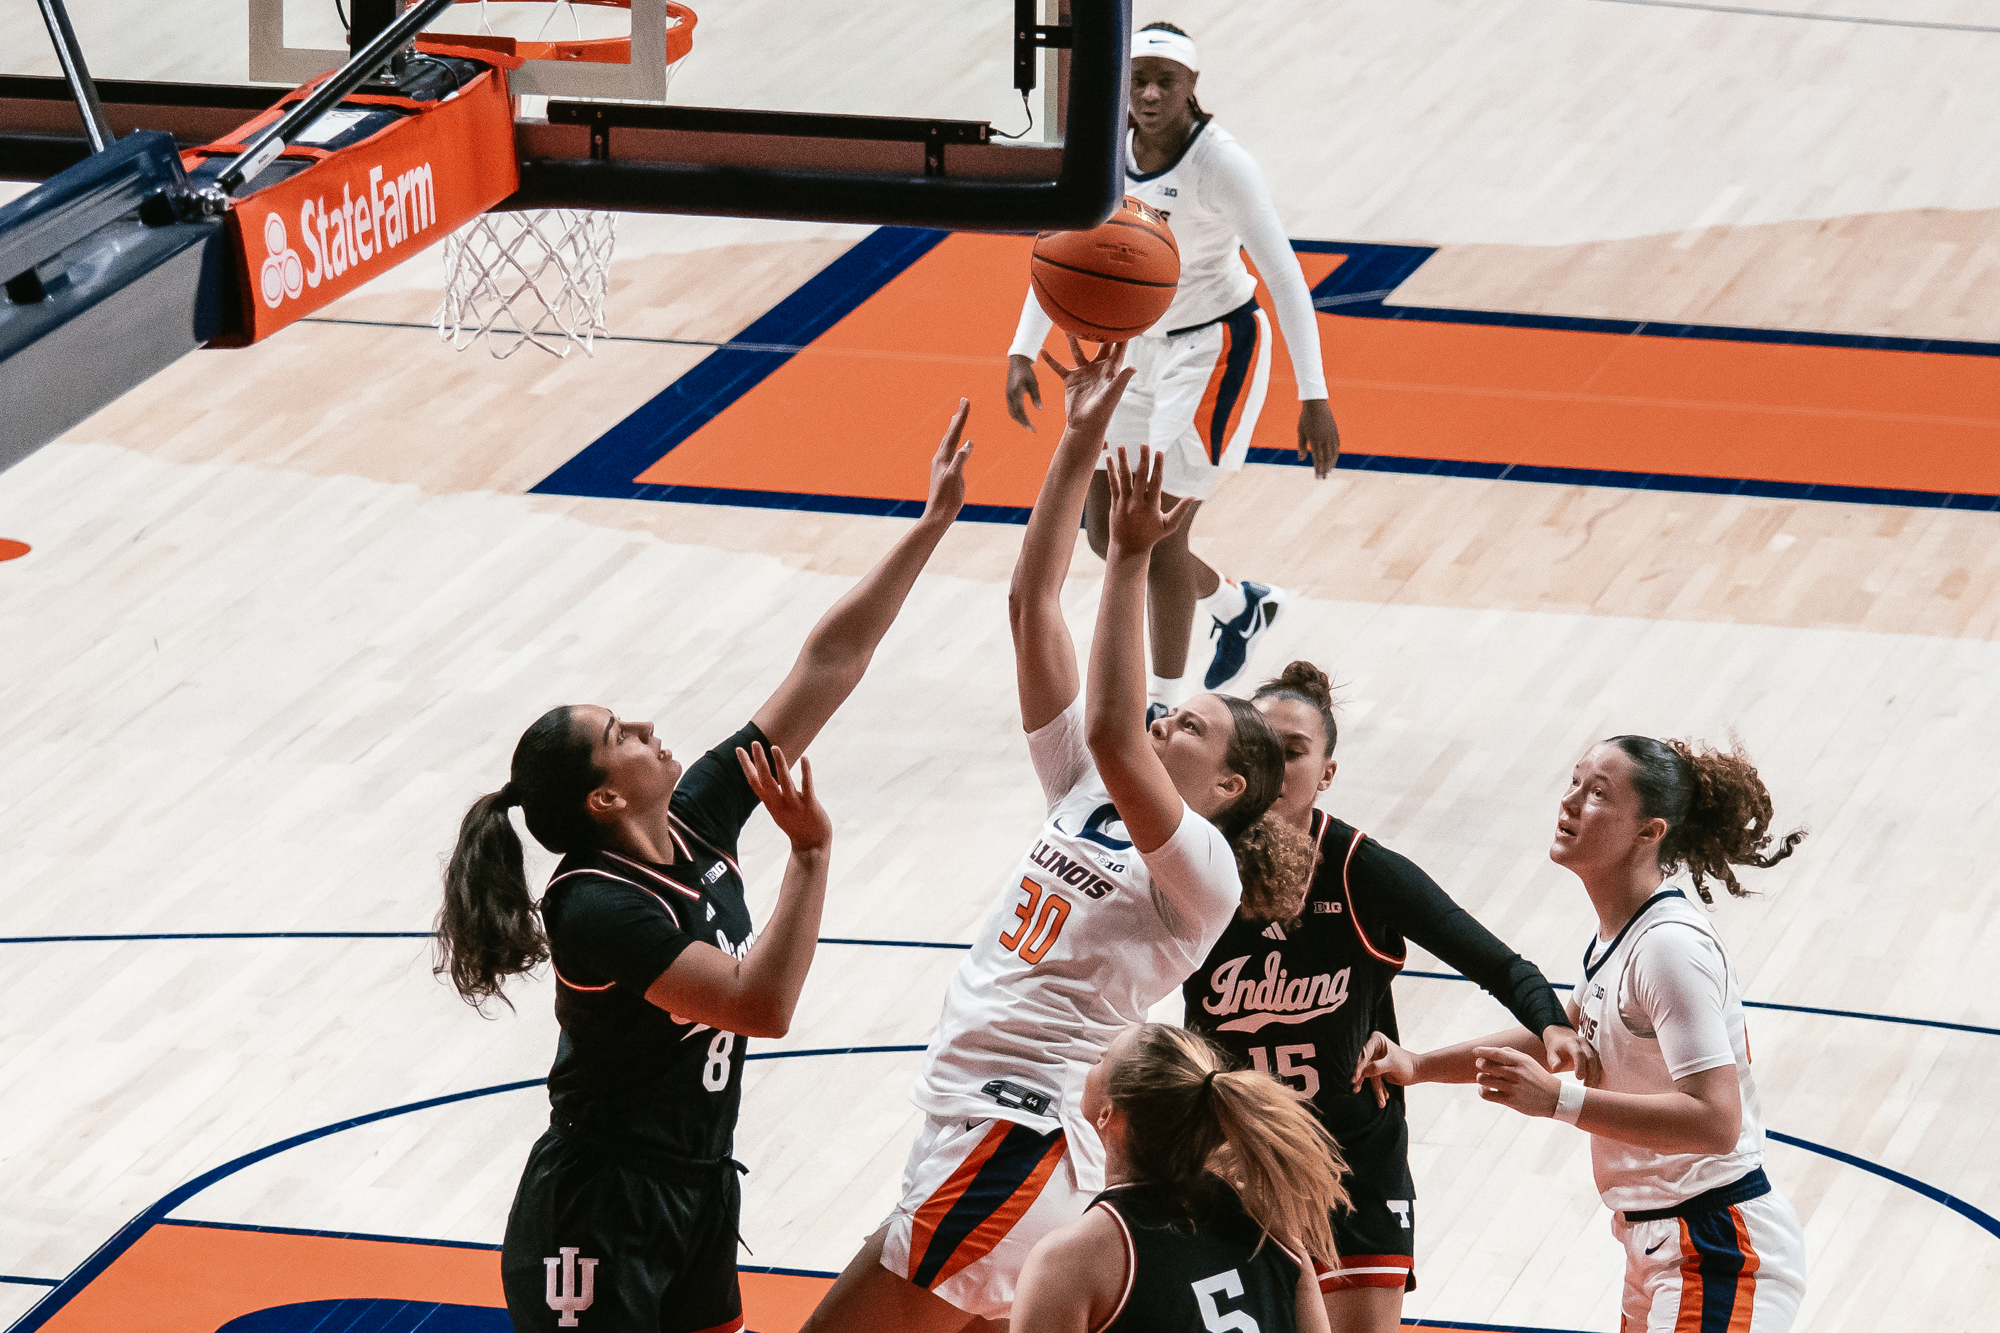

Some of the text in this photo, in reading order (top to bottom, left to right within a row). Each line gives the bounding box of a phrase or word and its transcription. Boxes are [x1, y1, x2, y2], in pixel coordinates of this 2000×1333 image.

[999, 875, 1072, 966] 30
[1202, 950, 1352, 1018] Indiana
[702, 1029, 736, 1092] 8
[1026, 1096, 1038, 1107] 44
[1190, 1268, 1261, 1333] 5
